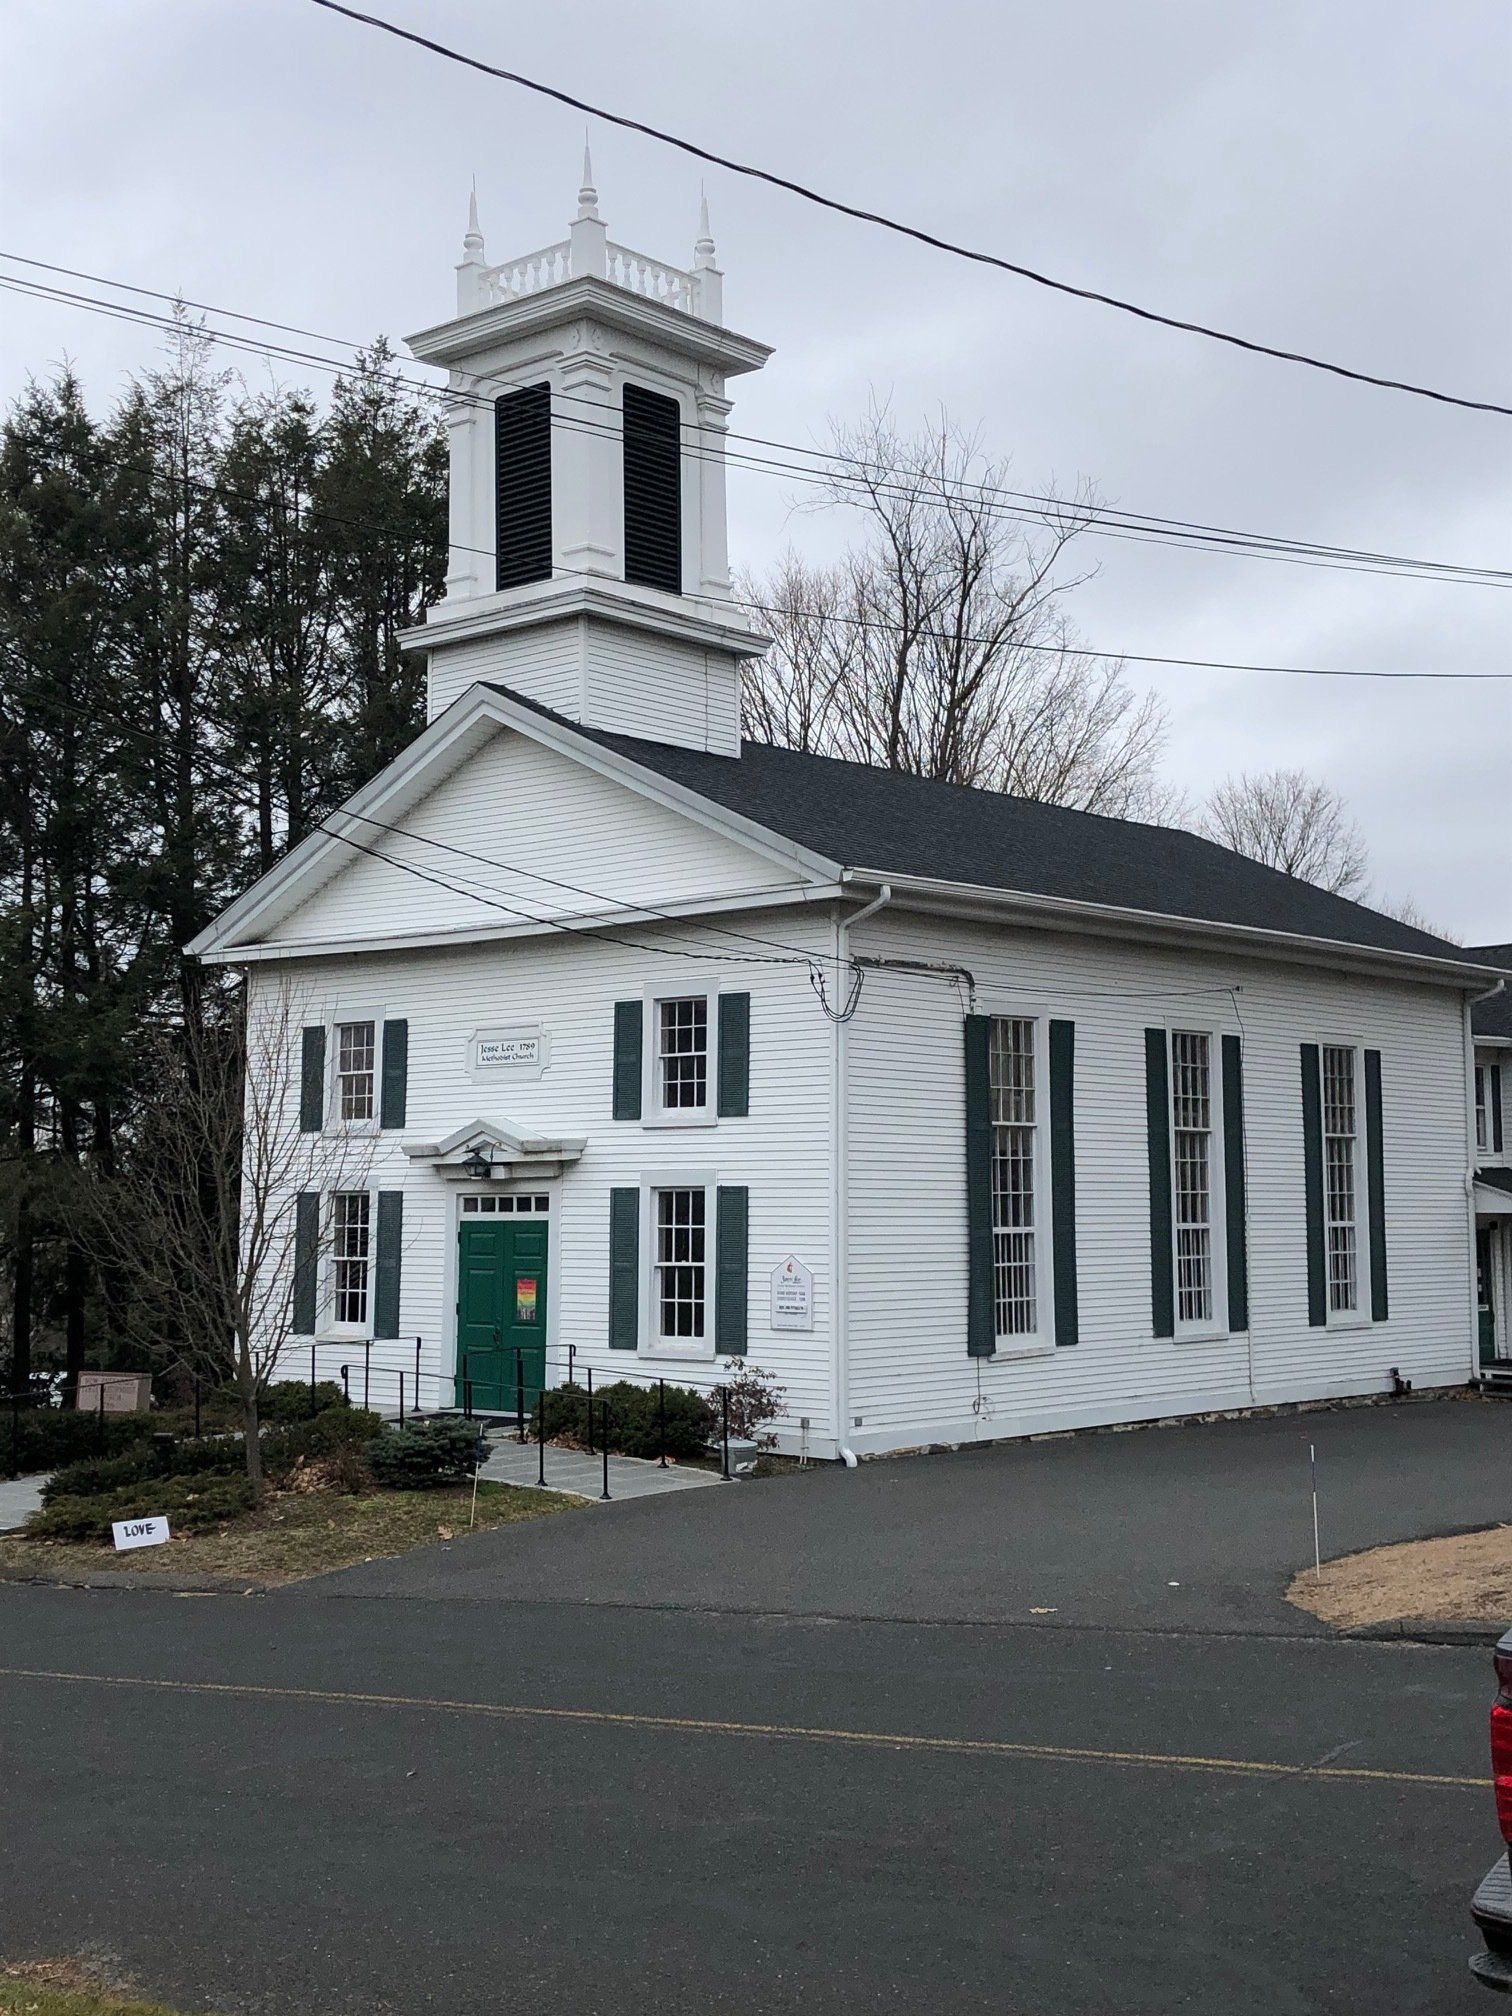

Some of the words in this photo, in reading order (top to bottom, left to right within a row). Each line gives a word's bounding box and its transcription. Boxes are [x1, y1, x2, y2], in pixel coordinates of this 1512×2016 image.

[481, 1044, 499, 1055] Jesse
[501, 1043, 515, 1052] Lee
[519, 1042, 536, 1051] 1789
[512, 1052, 534, 1060] Church
[123, 1523, 156, 1537] LOVE
